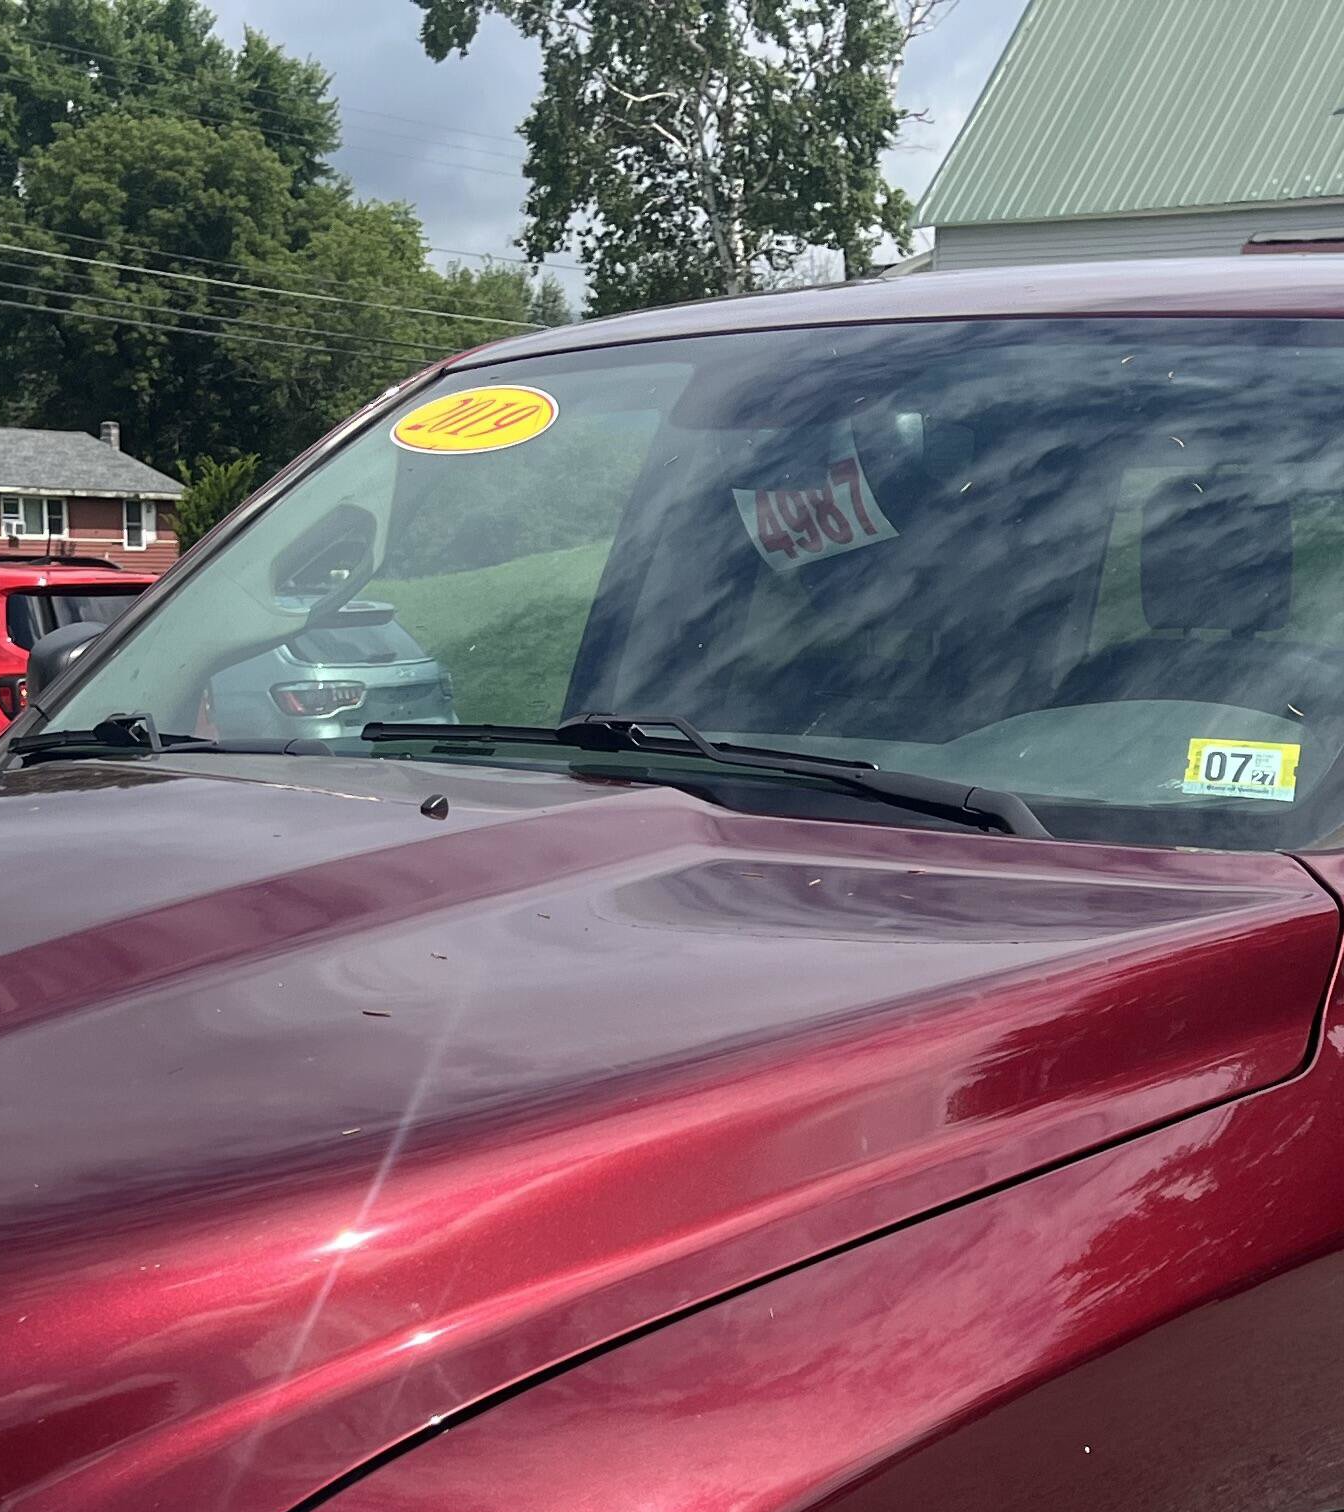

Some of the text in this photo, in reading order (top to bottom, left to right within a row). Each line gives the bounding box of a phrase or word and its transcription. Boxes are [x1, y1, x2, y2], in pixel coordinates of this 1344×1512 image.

[406, 397, 541, 438] 2019
[755, 456, 878, 561] 4987
[1205, 751, 1253, 783] 07
